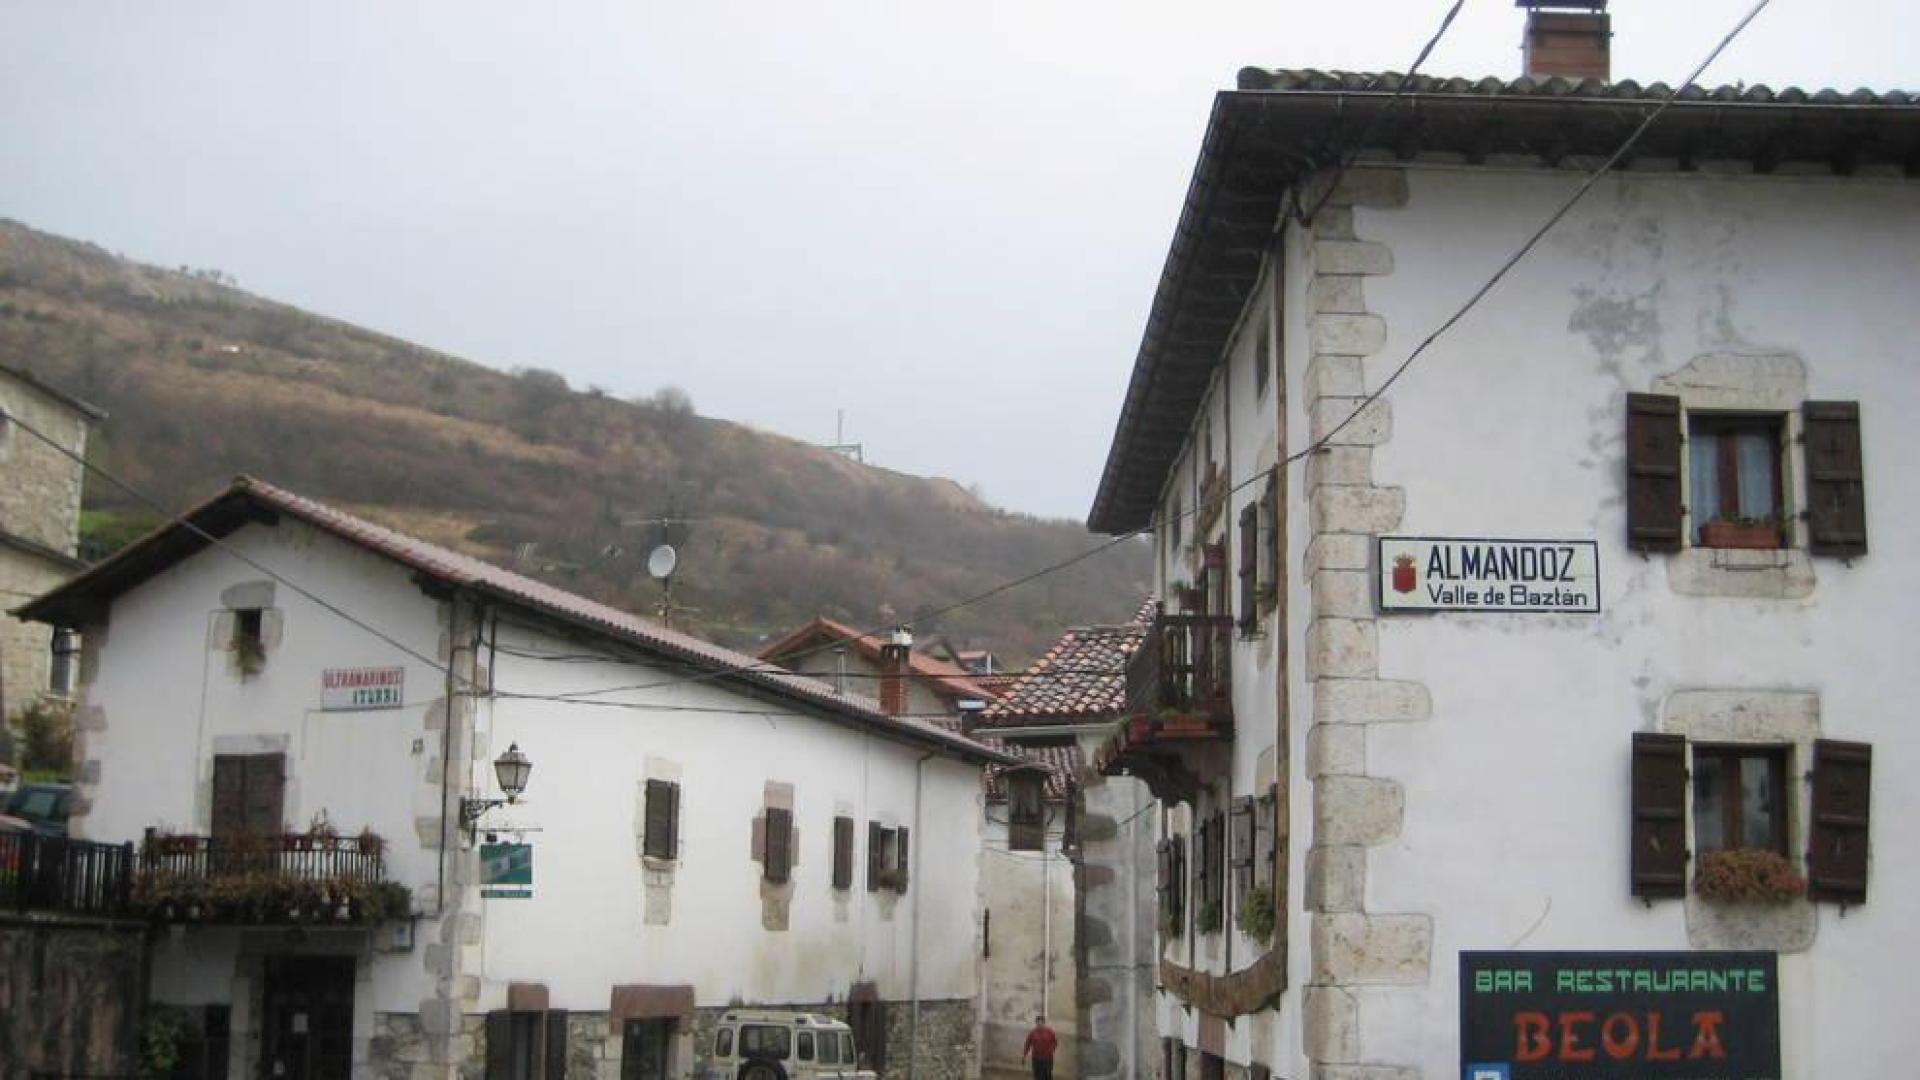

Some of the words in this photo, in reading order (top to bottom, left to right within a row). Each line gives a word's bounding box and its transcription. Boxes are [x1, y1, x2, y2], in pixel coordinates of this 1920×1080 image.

[1426, 545, 1576, 582] ALMANDOZ
[1427, 583, 1479, 605] Valle
[1484, 586, 1506, 605] de
[1510, 584, 1588, 606] Baztán
[1474, 968, 1533, 993] BAR
[1556, 967, 1767, 993] RESTAURANTE
[1512, 1010, 1728, 1062] BEOLA
